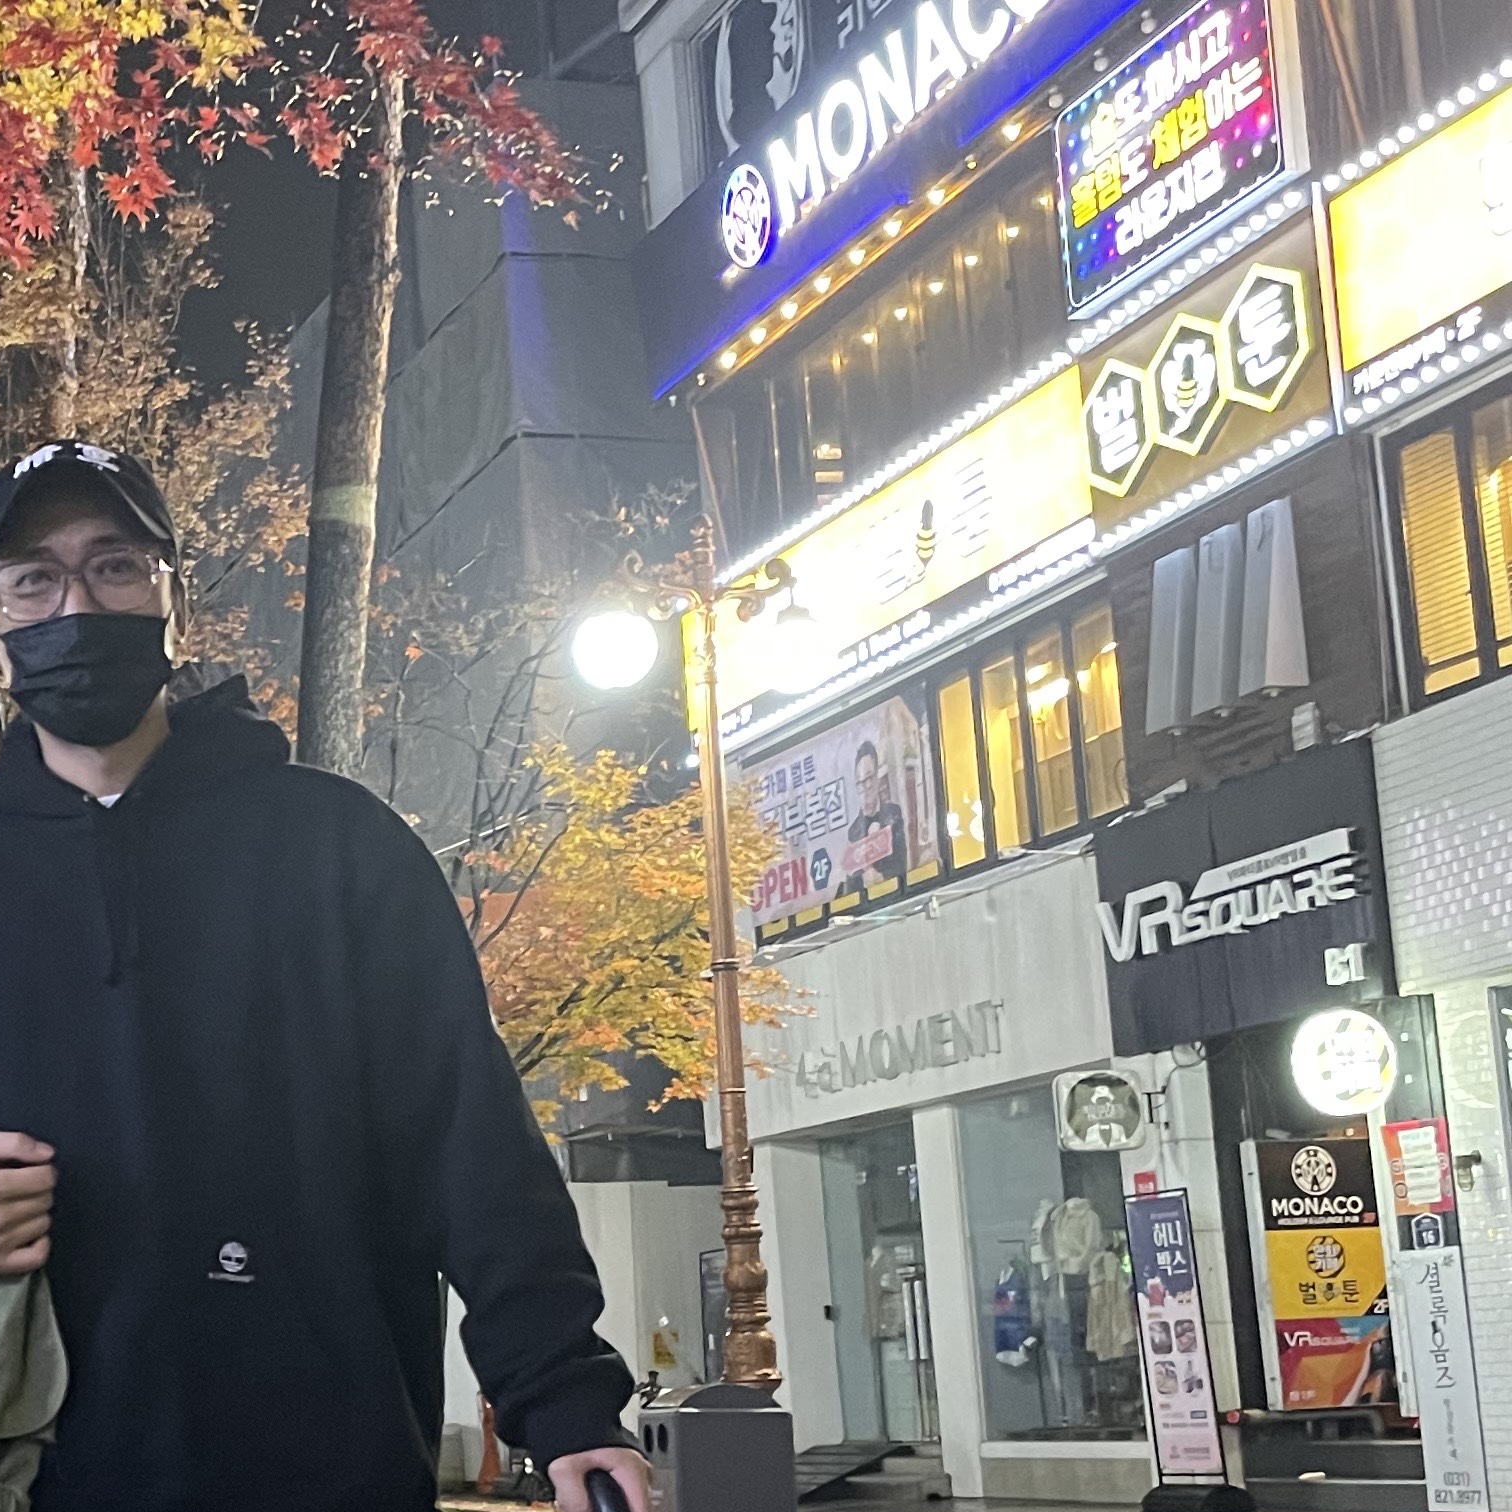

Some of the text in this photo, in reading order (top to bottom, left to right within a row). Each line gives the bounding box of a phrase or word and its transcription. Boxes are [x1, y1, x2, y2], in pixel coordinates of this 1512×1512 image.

[1142, 10, 1230, 112] 마시고
[767, 0, 1044, 230] MONAC
[1150, 57, 1263, 170] 체험하는
[752, 855, 830, 913] OPEN 2F
[1324, 943, 1366, 986] B1
[839, 998, 1004, 1089] MOMENT
[1271, 1195, 1364, 1217] MONACO
[1152, 1220, 1183, 1248] 허니
[1422, 1231, 1437, 1246] 16
[1156, 1250, 1188, 1276] 박스
